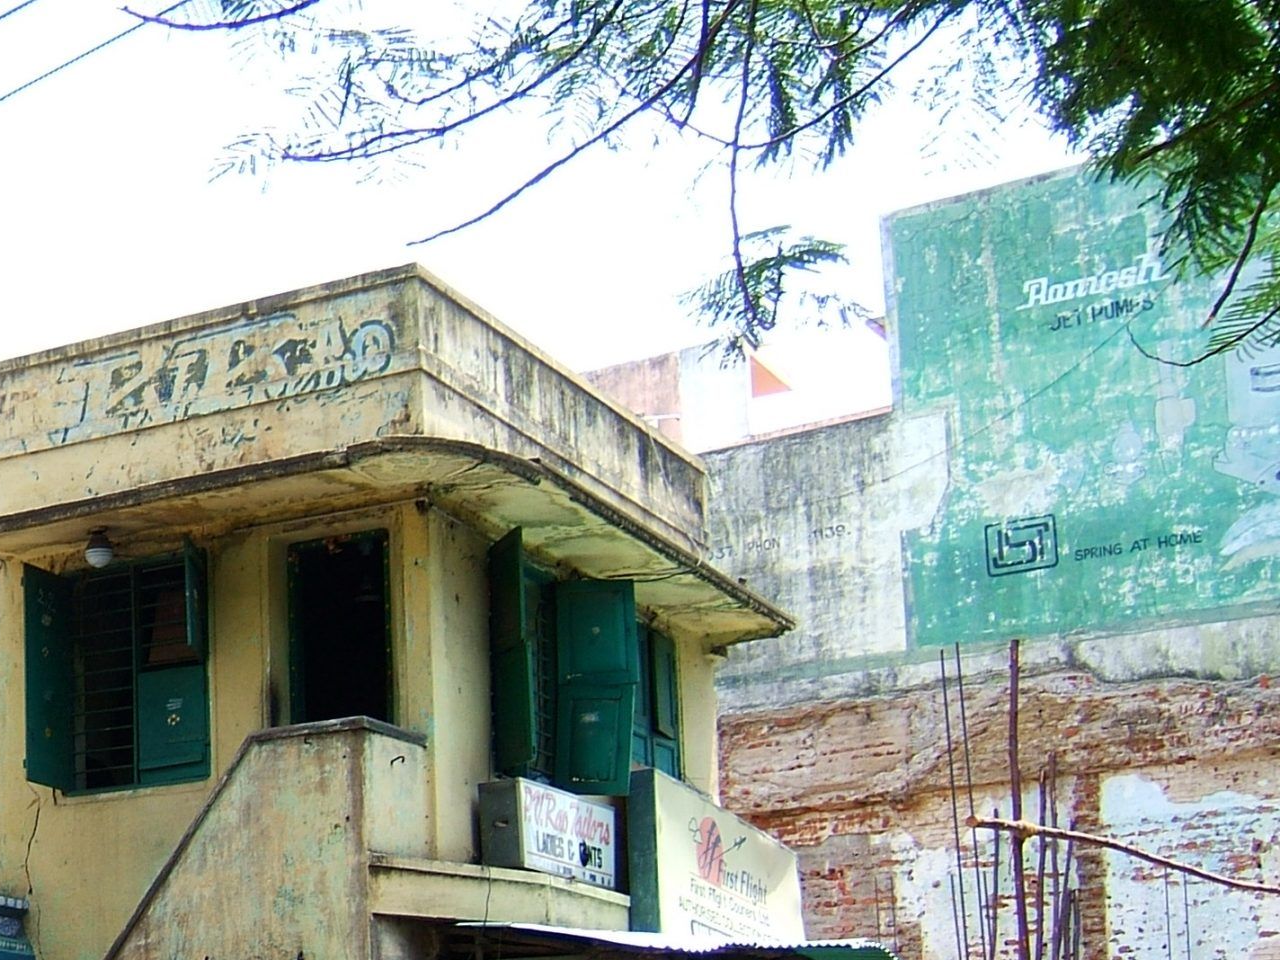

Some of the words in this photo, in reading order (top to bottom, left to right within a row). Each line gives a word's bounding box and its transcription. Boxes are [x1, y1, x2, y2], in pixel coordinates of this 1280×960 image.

[1074, 543, 1123, 562] SPRING
[1130, 538, 1150, 553] AT
[1158, 530, 1203, 550] HOME
[717, 859, 738, 891] First
[740, 870, 768, 906] Flight
